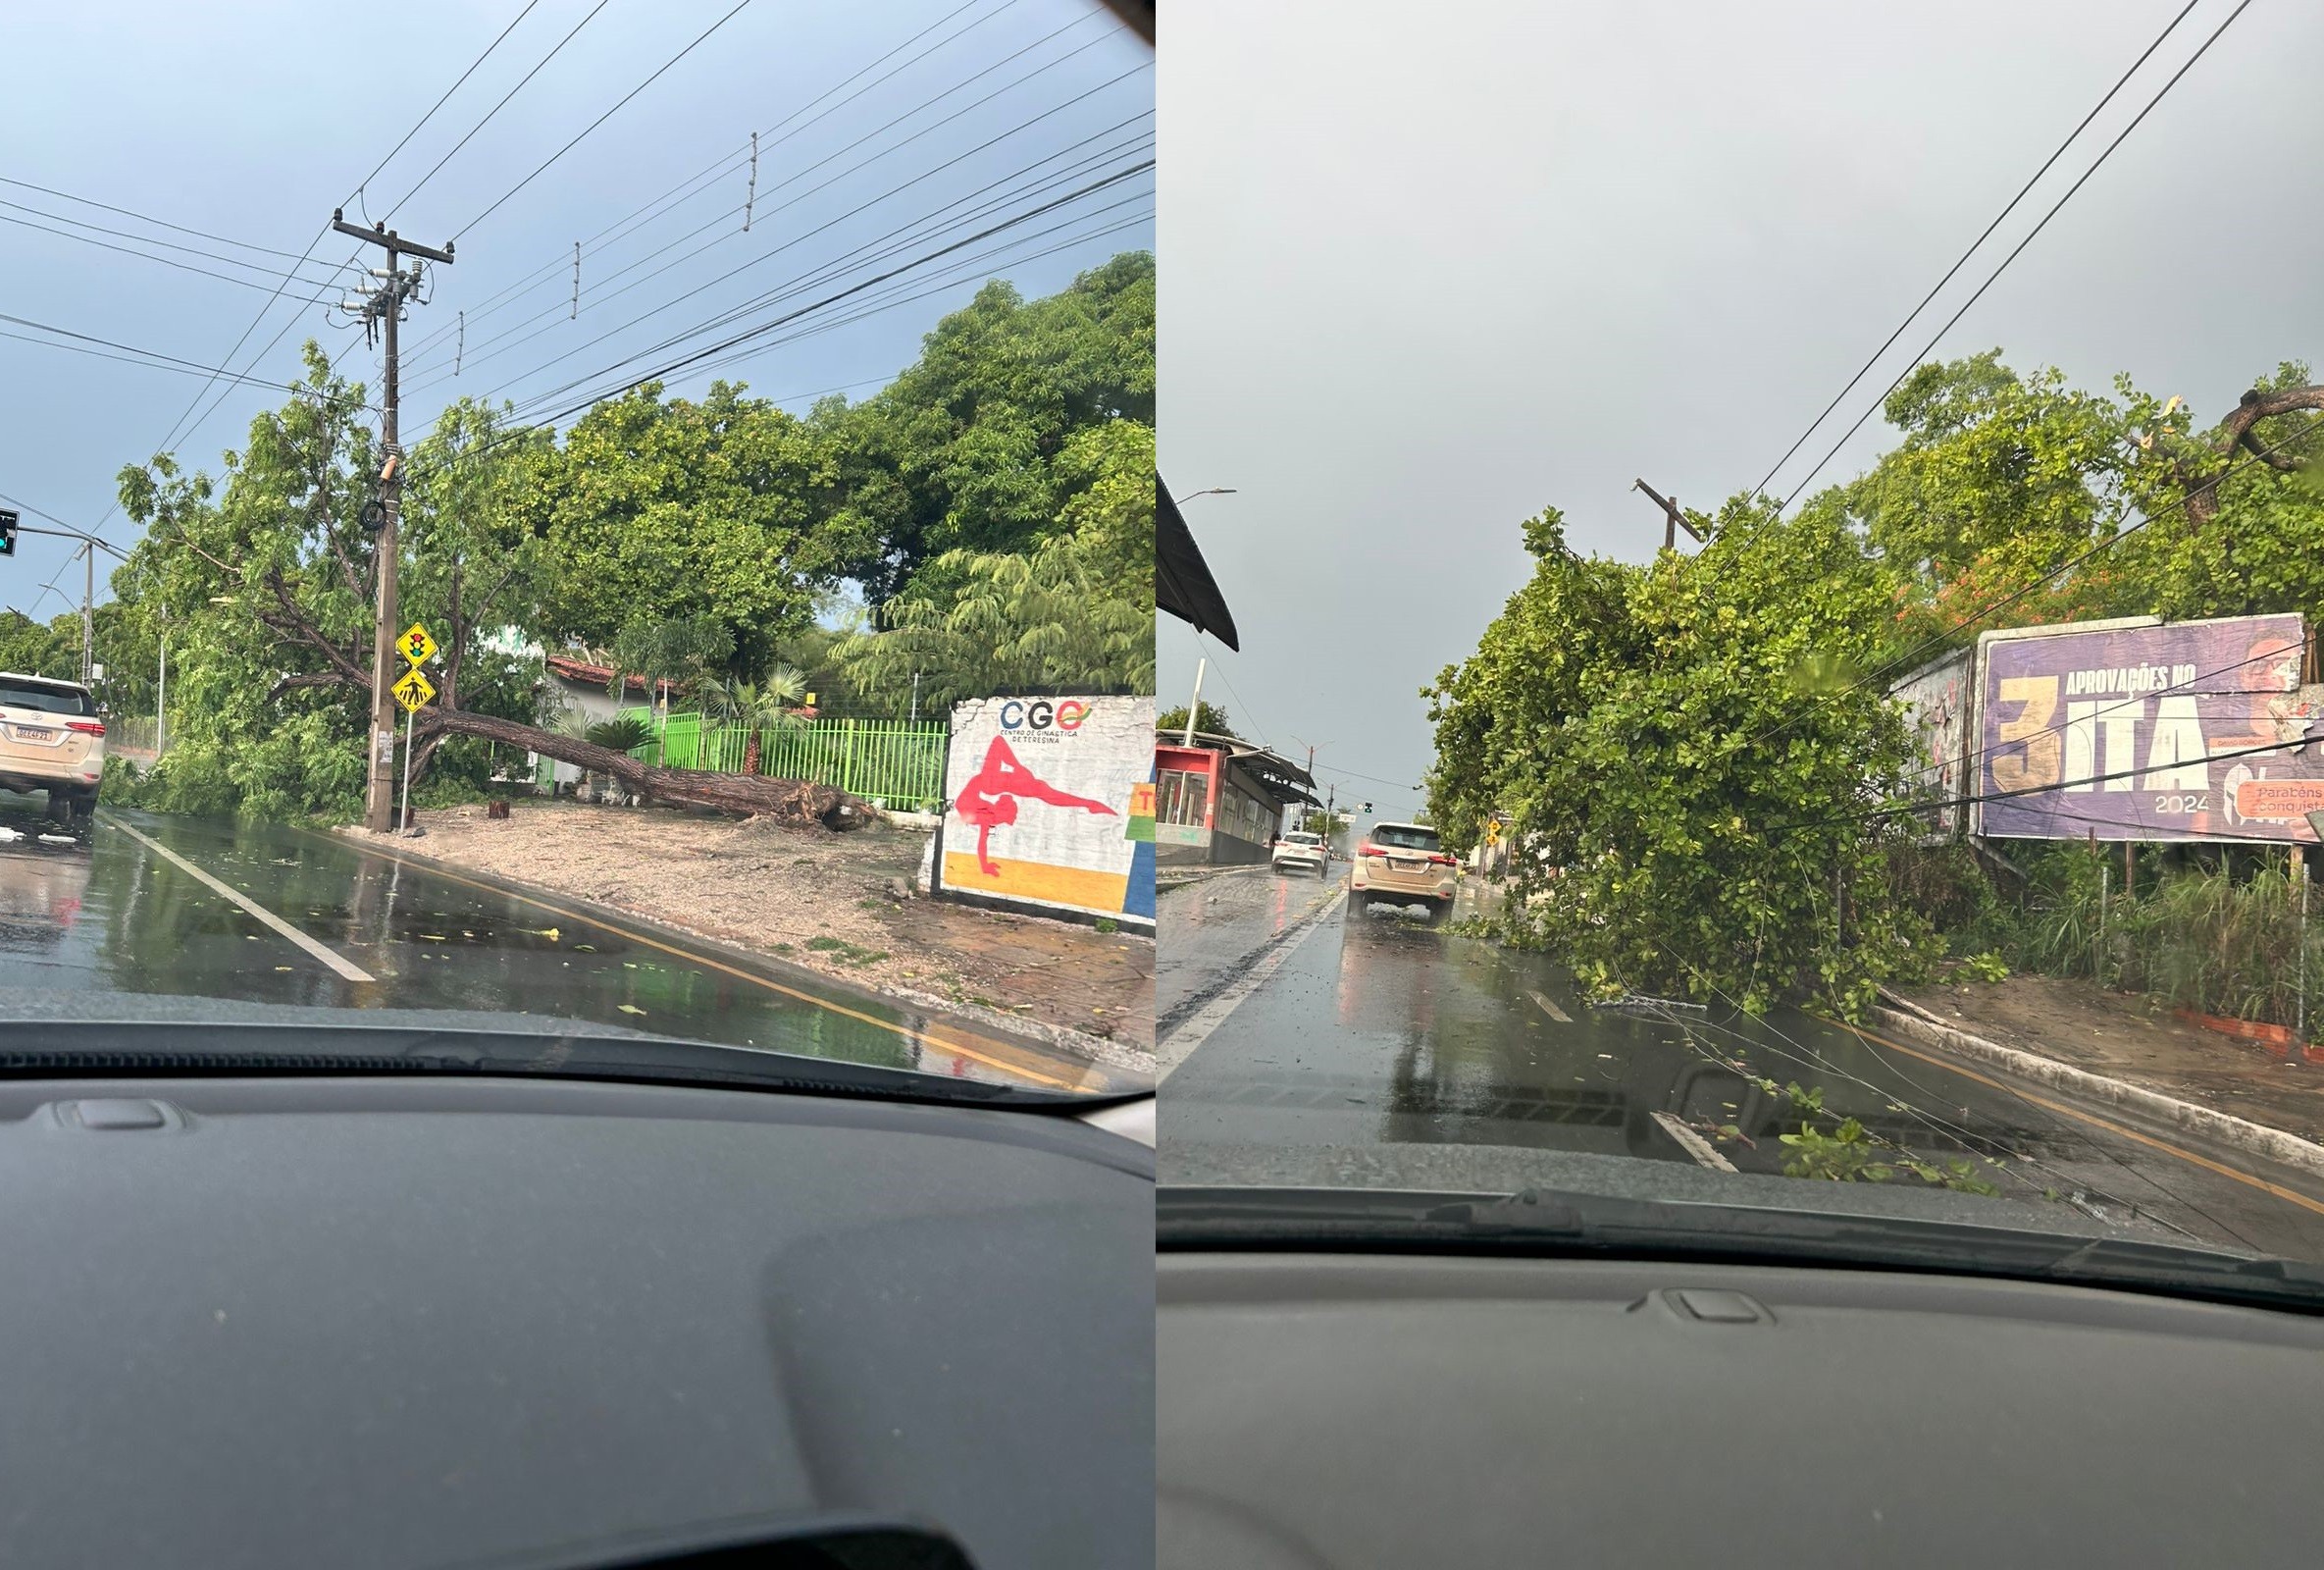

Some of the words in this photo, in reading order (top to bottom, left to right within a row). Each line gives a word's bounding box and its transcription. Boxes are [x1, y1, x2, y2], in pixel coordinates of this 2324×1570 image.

[2066, 662, 2168, 700] APROVAÇÕES
[2172, 663, 2196, 689] NO
[1992, 675, 2062, 797] 3
[2064, 695, 2210, 793] ITA
[2258, 786, 2322, 798] Parabéns
[2155, 795, 2209, 813] 2024
[2259, 802, 2324, 812] conquist
